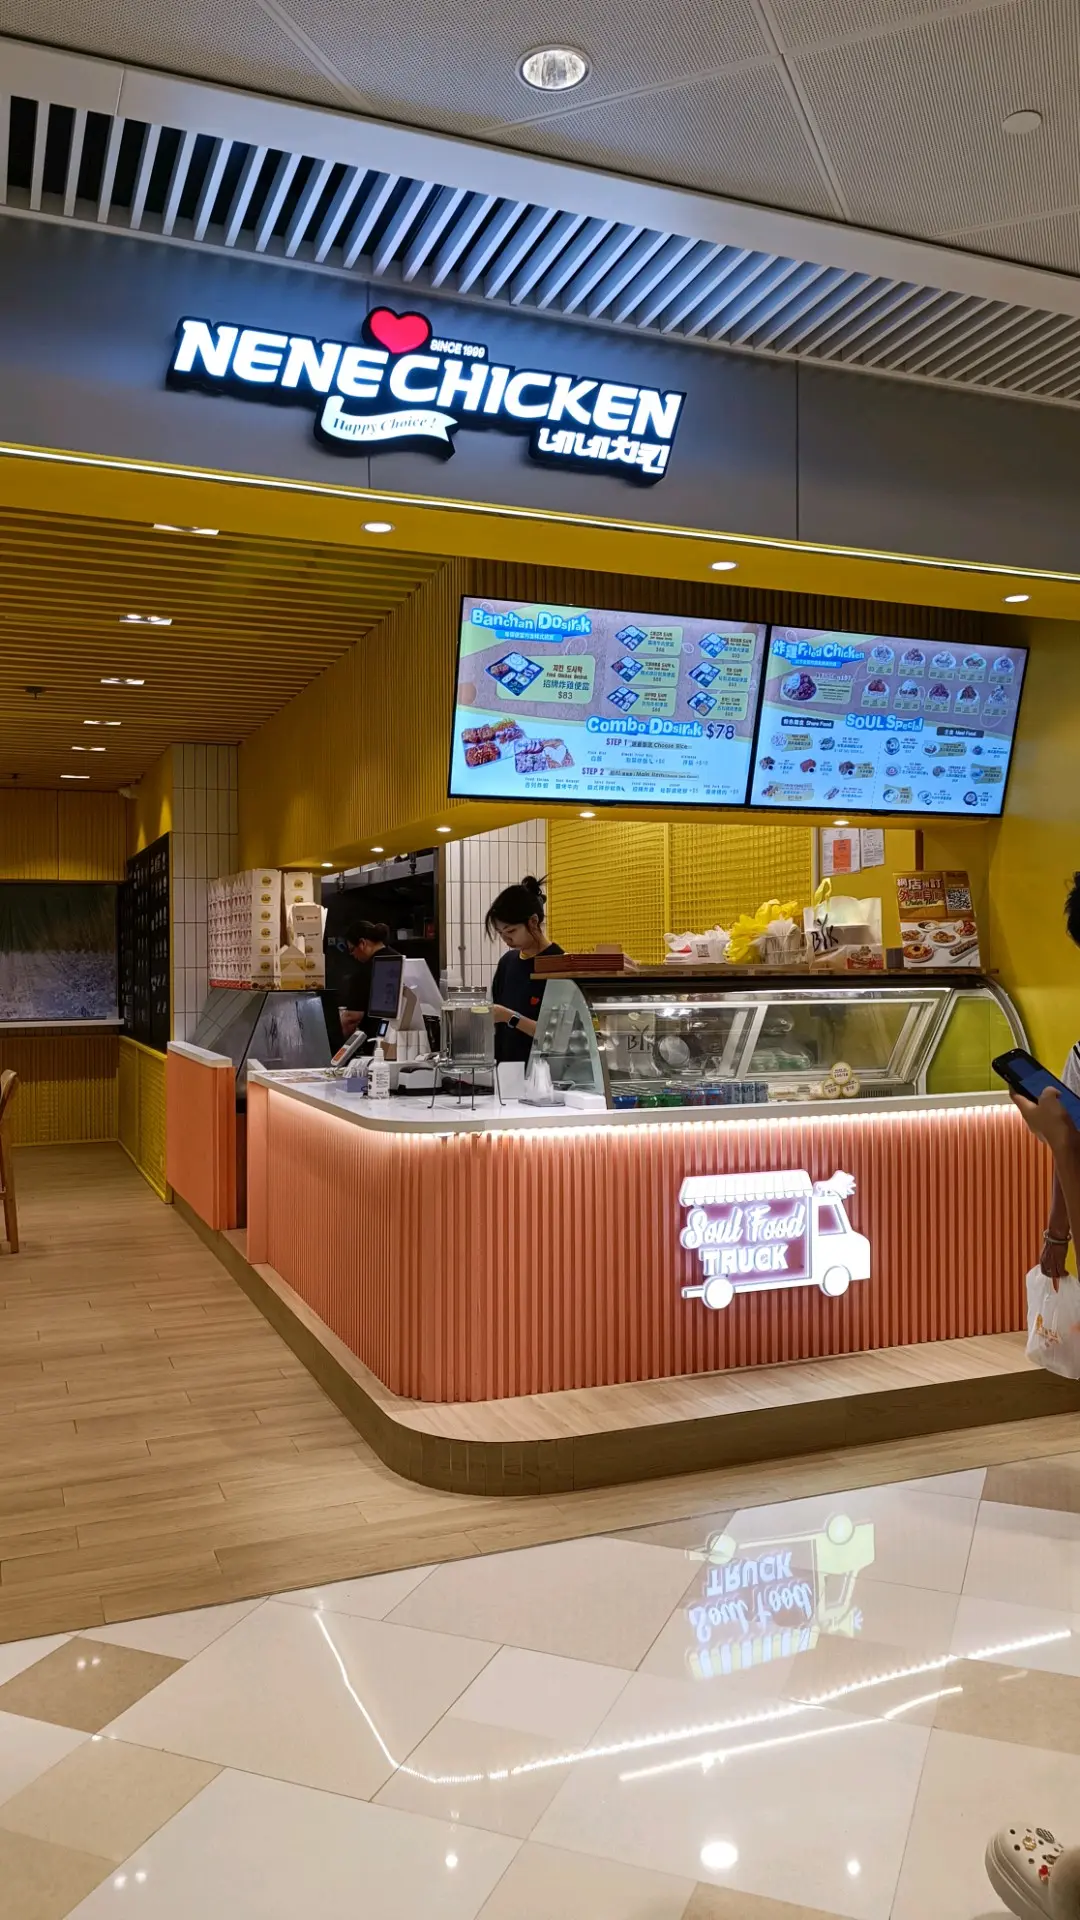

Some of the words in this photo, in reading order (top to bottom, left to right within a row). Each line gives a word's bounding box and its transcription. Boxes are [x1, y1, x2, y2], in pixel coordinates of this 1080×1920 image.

[430, 339, 461, 355] SINCE
[462, 345, 486, 358] 1999
[333, 417, 378, 436] Happy
[537, 427, 670, 474] 네네치킨
[472, 609, 534, 631] Banchan
[823, 643, 865, 659] Chicken
[557, 691, 573, 700] $83
[587, 716, 647, 733] Combo
[706, 722, 735, 740] $78
[886, 714, 923, 731] Special
[606, 737, 622, 747] STEP
[624, 738, 628, 747] 1
[582, 767, 598, 775] STEP
[680, 1204, 743, 1250] Soul
[745, 1202, 807, 1243] Food
[700, 1242, 789, 1276] TRUCK
